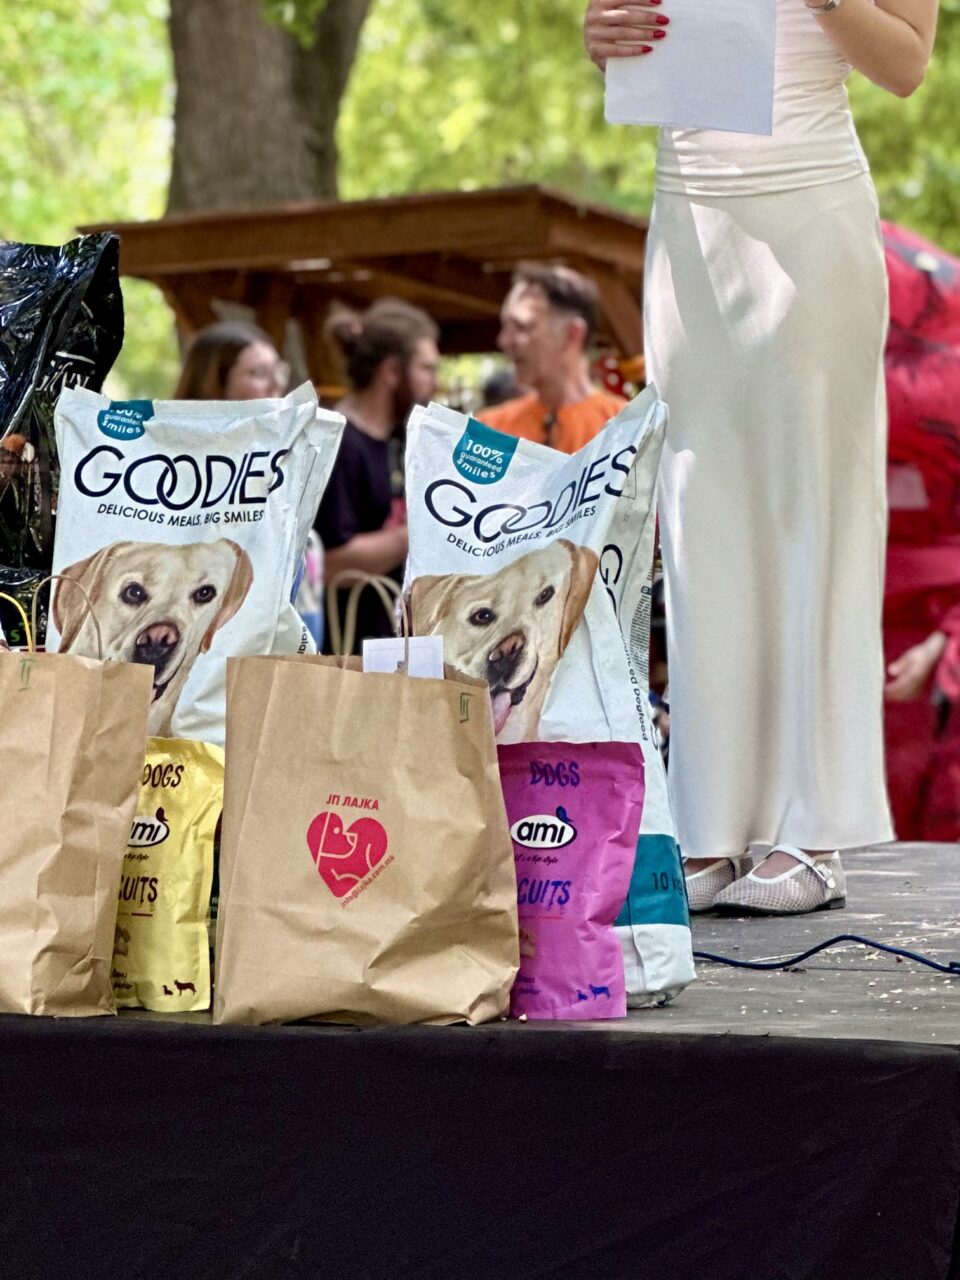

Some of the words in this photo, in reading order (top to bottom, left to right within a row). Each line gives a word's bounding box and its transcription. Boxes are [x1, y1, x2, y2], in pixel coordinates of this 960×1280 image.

[101, 420, 141, 433] smiles
[460, 451, 503, 473] guaranteed
[466, 439, 505, 464] 100%
[74, 445, 292, 510] GOODIES
[456, 457, 496, 478] smiles
[424, 445, 638, 543] GOODIES
[97, 503, 165, 524] DELICIOUS
[204, 512, 221, 524] BIG
[224, 510, 265, 523] SMILES
[446, 533, 505, 558] DELICIOUS
[506, 531, 542, 549] MEALS,
[633, 687, 648, 742] Dogfood
[530, 760, 580, 787] DOGS
[131, 822, 161, 842] mi
[517, 821, 566, 844] ami
[119, 876, 158, 903] UITS
[651, 871, 669, 891] 10
